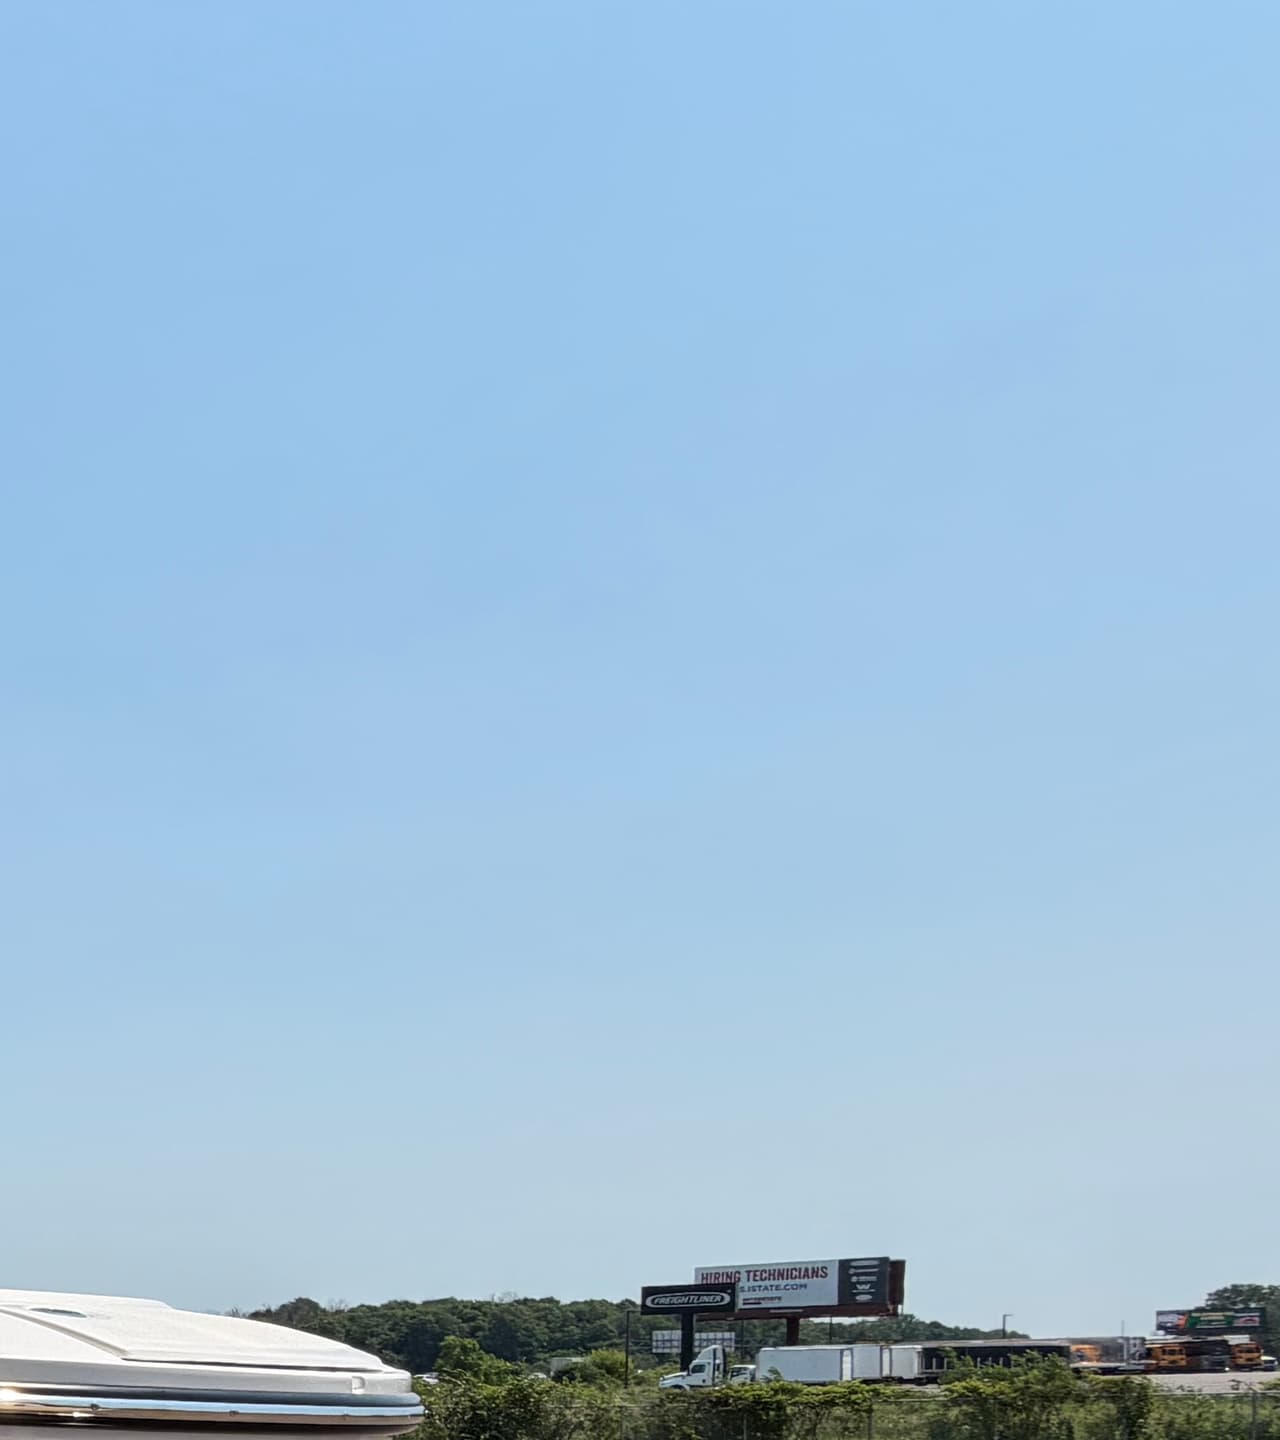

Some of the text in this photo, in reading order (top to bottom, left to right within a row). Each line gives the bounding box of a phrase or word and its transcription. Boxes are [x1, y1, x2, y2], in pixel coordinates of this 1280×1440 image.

[701, 1266, 828, 1285] HIRING TECHNICIANS
[654, 1295, 722, 1304] FREIGHTLINER
